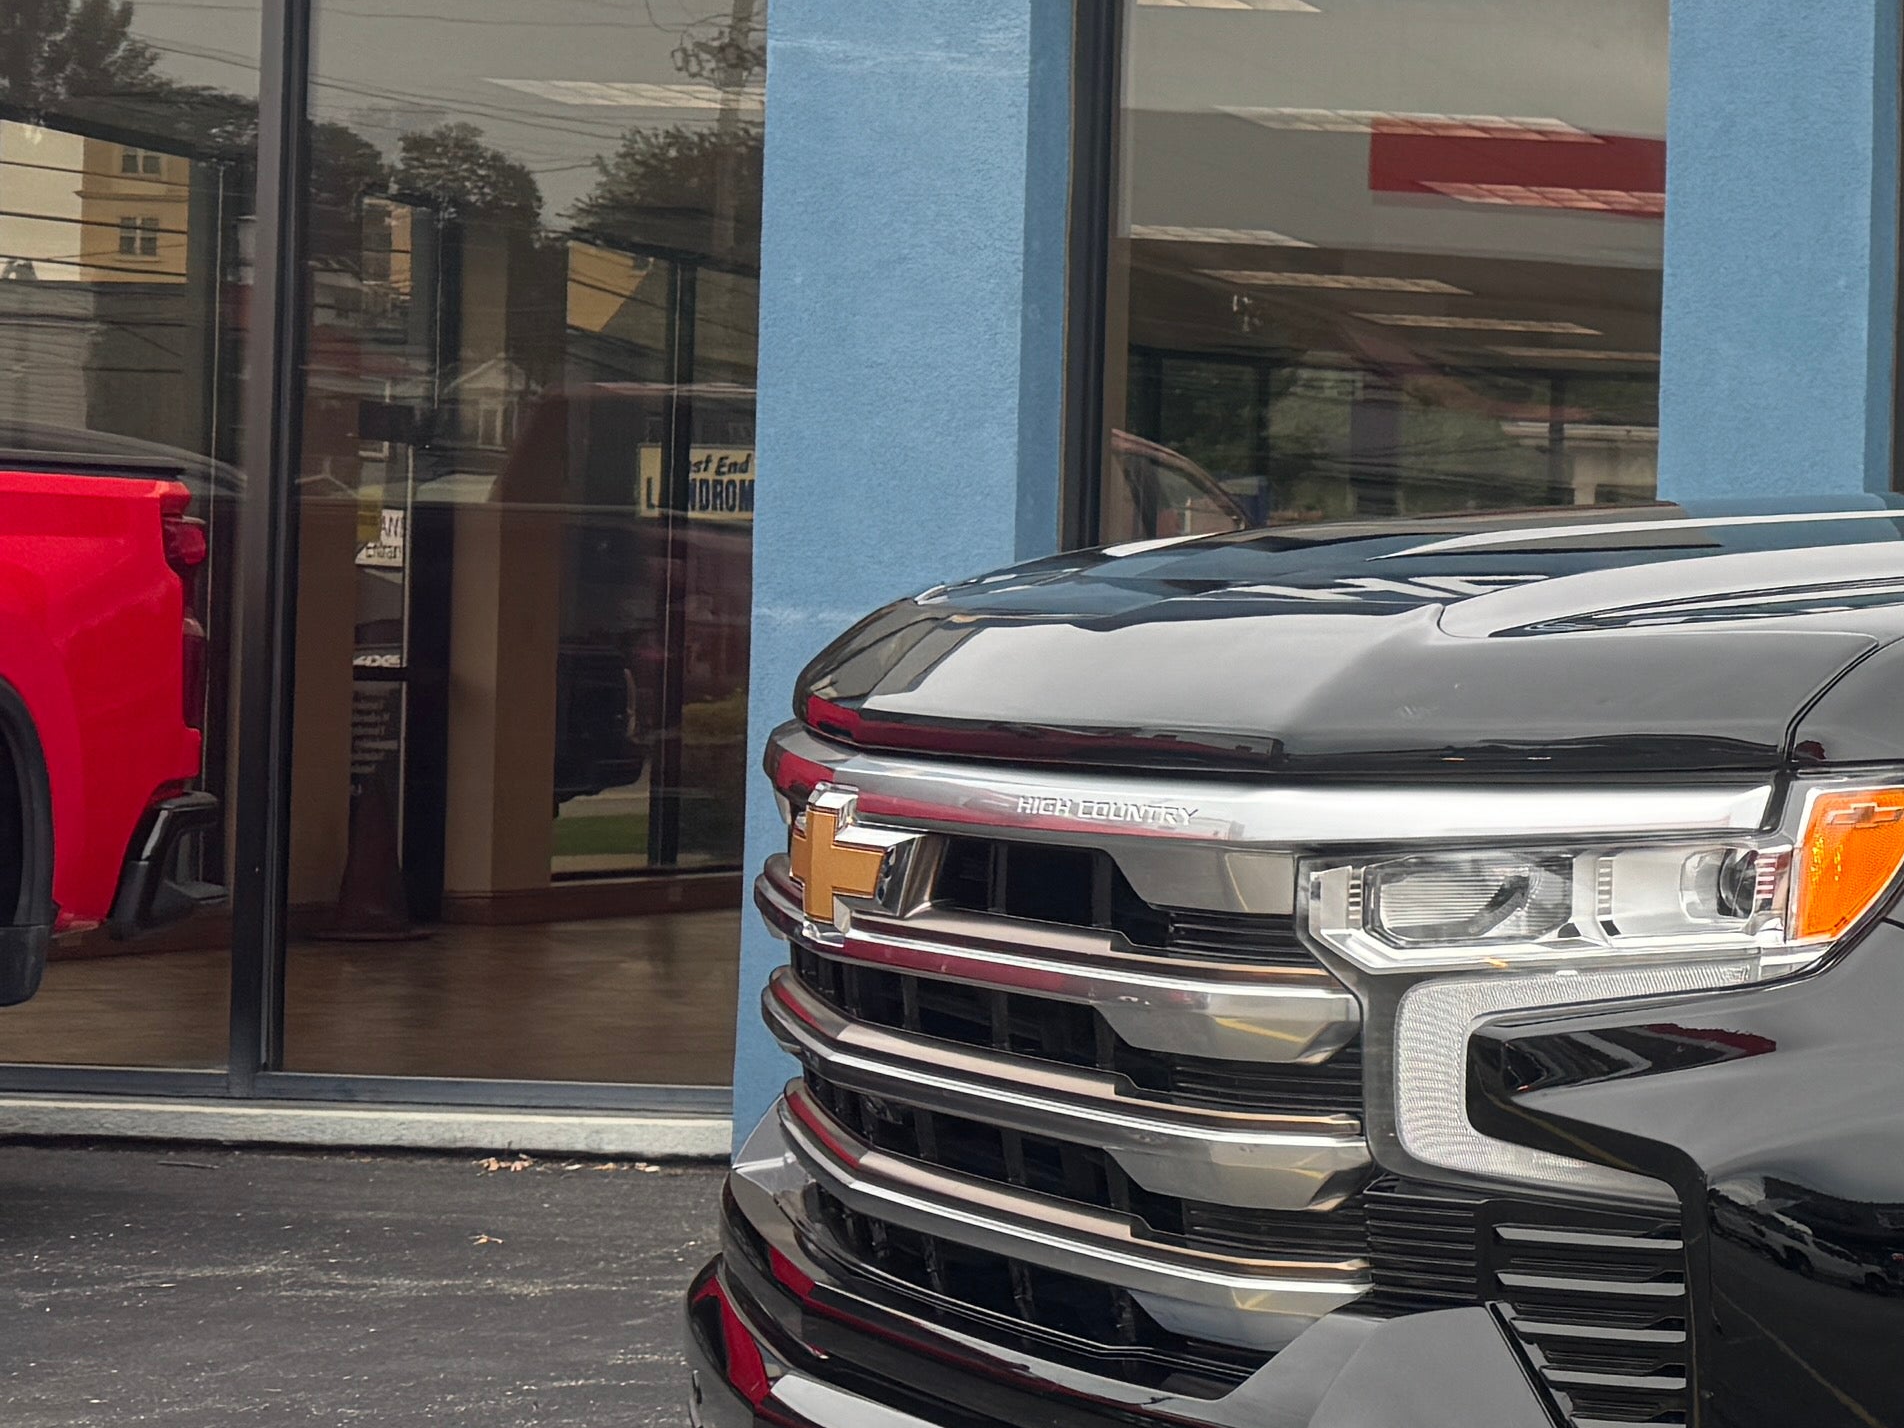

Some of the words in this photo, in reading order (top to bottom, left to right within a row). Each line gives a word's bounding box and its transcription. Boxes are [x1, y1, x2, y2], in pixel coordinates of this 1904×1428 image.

[715, 452, 753, 476] End
[646, 476, 755, 512] LNDROM
[1016, 795, 1073, 817] HIGH
[1076, 800, 1199, 827] COUNTRY
